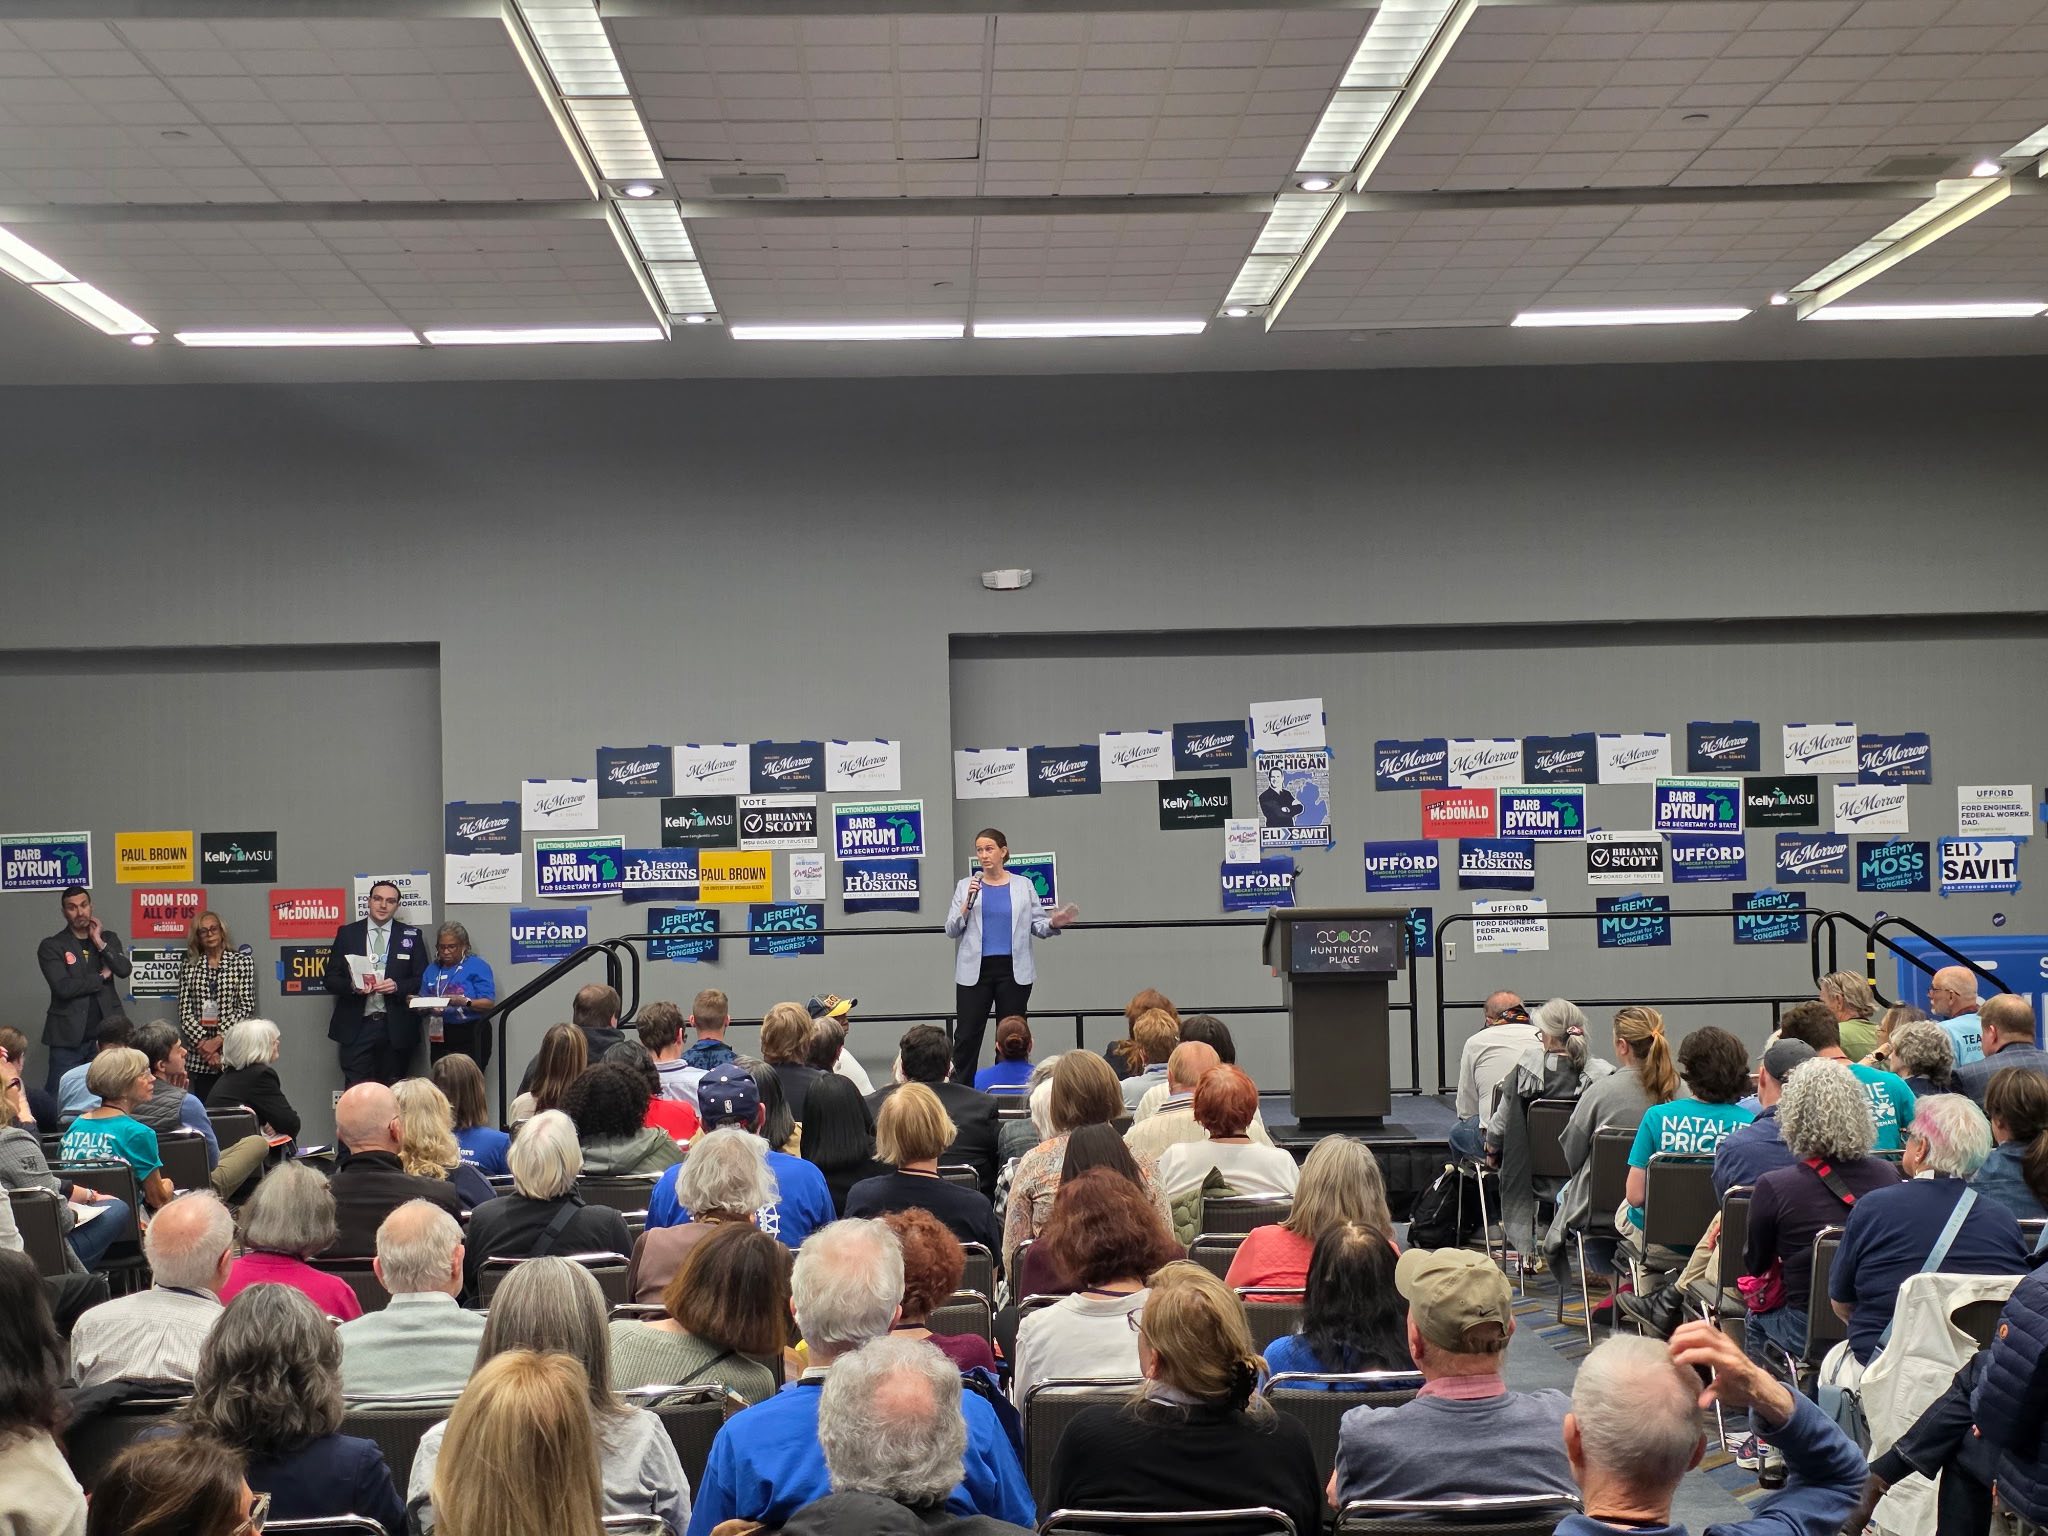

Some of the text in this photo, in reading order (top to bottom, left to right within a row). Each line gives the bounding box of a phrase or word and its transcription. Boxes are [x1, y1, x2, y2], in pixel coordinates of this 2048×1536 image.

[1263, 713, 1311, 733] McMorrow
[1185, 734, 1234, 754] McMorrow
[1698, 736, 1748, 754] McMorrow
[1785, 733, 1854, 758] McMorrow
[1112, 746, 1160, 764] McMorrow
[1450, 748, 1518, 772] McMorrow
[1535, 750, 1585, 769] McMorrow
[1609, 748, 1659, 766] McMorrow
[1859, 744, 1929, 770] McMorrow
[686, 760, 736, 777] McMorrow
[762, 756, 813, 774] McMorrow
[838, 755, 887, 773] McMorrow
[1038, 760, 1088, 779] McMorrow
[1259, 758, 1326, 770] MICHIGAN
[1376, 749, 1446, 776] McMorrow
[608, 761, 660, 780] McMorrow
[967, 763, 1015, 781] McMorrow
[534, 794, 585, 812] McMorrow
[1163, 796, 1226, 810] Kelly MSU
[1669, 791, 1695, 802] BARB
[1749, 794, 1812, 807] Kelly MSU
[1514, 800, 1540, 810] BARB
[1661, 803, 1714, 820] BYRUM
[1836, 793, 1904, 818] McMorrow
[1431, 806, 1488, 820] McDONALD
[1506, 811, 1559, 828] BYRUM
[457, 817, 509, 835] McMorrow
[665, 815, 730, 829] Kelly MSU
[766, 821, 812, 832] SCOTT
[849, 818, 876, 829] BARB
[842, 829, 895, 848] BYRUM
[1263, 828, 1325, 839] ELI SAVIT
[14, 849, 41, 860] BARB
[121, 848, 187, 861] PAUL BROWN
[1486, 850, 1523, 860] Jason
[1672, 847, 1744, 861] UFFORD
[1777, 842, 1847, 868] McMorrow
[1871, 843, 1914, 861] JEREMY
[1944, 843, 1970, 856] ELI
[205, 851, 271, 864] Kelly MSU
[550, 854, 577, 865] BARB
[1366, 856, 1438, 870] UFFORD
[1461, 854, 1532, 869] HOSKINS
[1612, 856, 1658, 866] SCOTT
[7, 860, 61, 879] BYRUM
[651, 861, 688, 870] Jason
[1863, 853, 1924, 878] MOSS
[1944, 859, 2014, 880] SAVIT
[457, 867, 509, 884] McMorrow
[543, 865, 597, 883] BYRUM
[624, 866, 696, 880] HOSKINS
[702, 868, 766, 881] PAUL BROWN
[871, 871, 908, 881] Jason
[1877, 874, 1904, 882] Democrat
[846, 876, 916, 891] HOSKINS
[1222, 874, 1293, 889] UFFORD
[1877, 879, 1912, 889] CONGRESS
[141, 894, 198, 906] ROOM FOR
[1611, 898, 1654, 911] JEREMY
[1747, 894, 1790, 909] JEREMY
[144, 906, 194, 919] ALL OF US
[279, 907, 339, 920] McDONALD
[662, 911, 706, 928] JEREMY
[763, 905, 807, 924] JEREMY
[1739, 903, 1800, 929] MOSS
[1603, 907, 1664, 934] MOSS
[512, 926, 586, 940] UFFORD
[1617, 929, 1643, 939] Democrat
[1753, 924, 1779, 933] Democrat
[1754, 929, 1789, 940] CONGRESS
[769, 937, 799, 946] Democrat
[1618, 933, 1652, 945] CONGRESS
[667, 942, 694, 951] Democrat
[667, 947, 703, 957] CONGRESS
[769, 942, 805, 954] CONGRESS
[1311, 946, 1378, 954] HUNTINGTON
[1329, 956, 1360, 964] PLACE
[134, 971, 180, 980] CALLO
[1963, 1034, 1982, 1044] TEA
[61, 1132, 116, 1148] ATALIE
